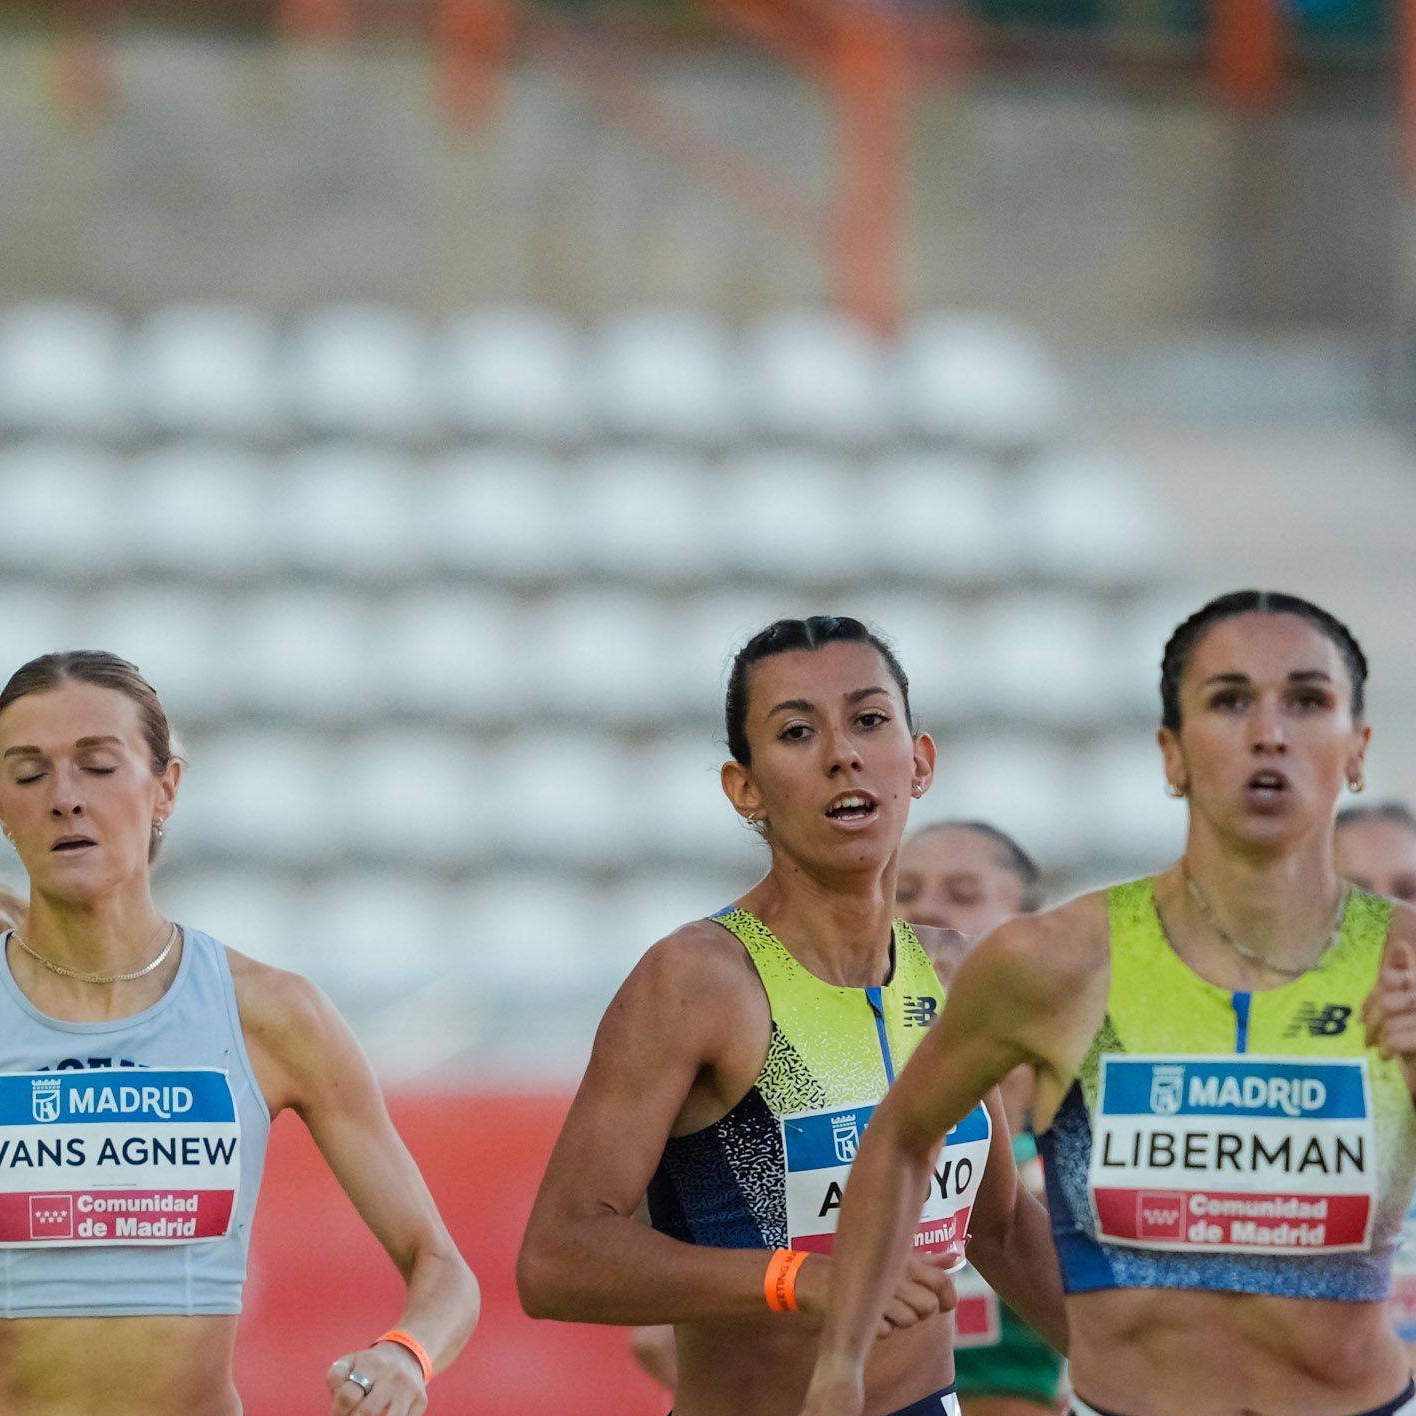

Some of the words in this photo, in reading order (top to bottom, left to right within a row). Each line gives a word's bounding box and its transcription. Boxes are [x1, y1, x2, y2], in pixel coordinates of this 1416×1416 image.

[69, 1087, 193, 1118] MADRID
[1189, 1075, 1326, 1115] MADRID
[97, 1137, 237, 1166] AGNEW
[1102, 1132, 1365, 1173] LIBERMAN
[77, 1195, 198, 1213] Comunidad
[1189, 1195, 1328, 1220] Comunidad
[78, 1219, 107, 1238] de
[115, 1218, 196, 1237] Madrid
[1188, 1220, 1223, 1243] de
[1230, 1221, 1325, 1246] Madrid
